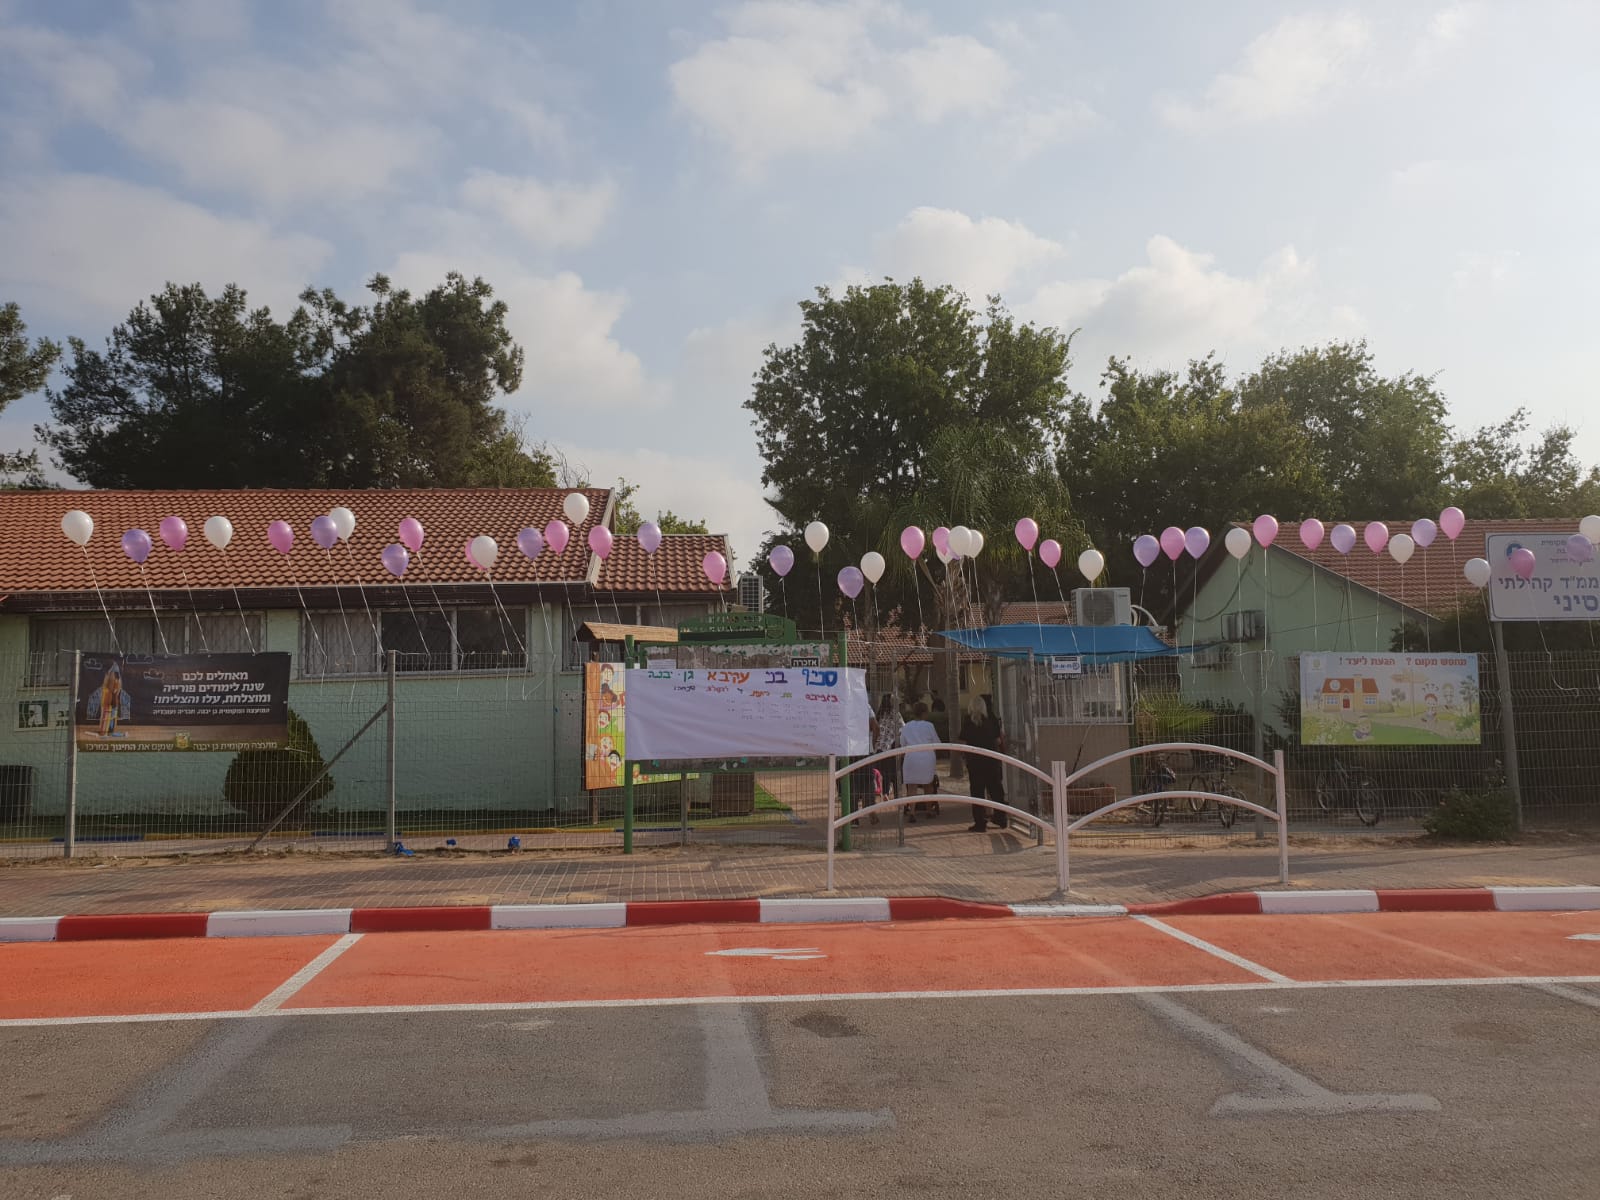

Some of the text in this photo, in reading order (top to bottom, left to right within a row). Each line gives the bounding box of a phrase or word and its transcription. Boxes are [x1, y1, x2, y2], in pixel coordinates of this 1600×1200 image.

[1498, 574, 1600, 592] ממ"ד קהילתי
[1553, 595, 1599, 611] סיני
[793, 659, 817, 667] אזכרה
[1414, 658, 1438, 667] מקום
[182, 671, 248, 681] מאחלים לכם
[648, 668, 838, 687] סניף בני עקיבא גן יבנה
[163, 682, 264, 692] שנת לימודים פורייה
[153, 693, 271, 704] ומוצלחת, עלו והצליחו!
